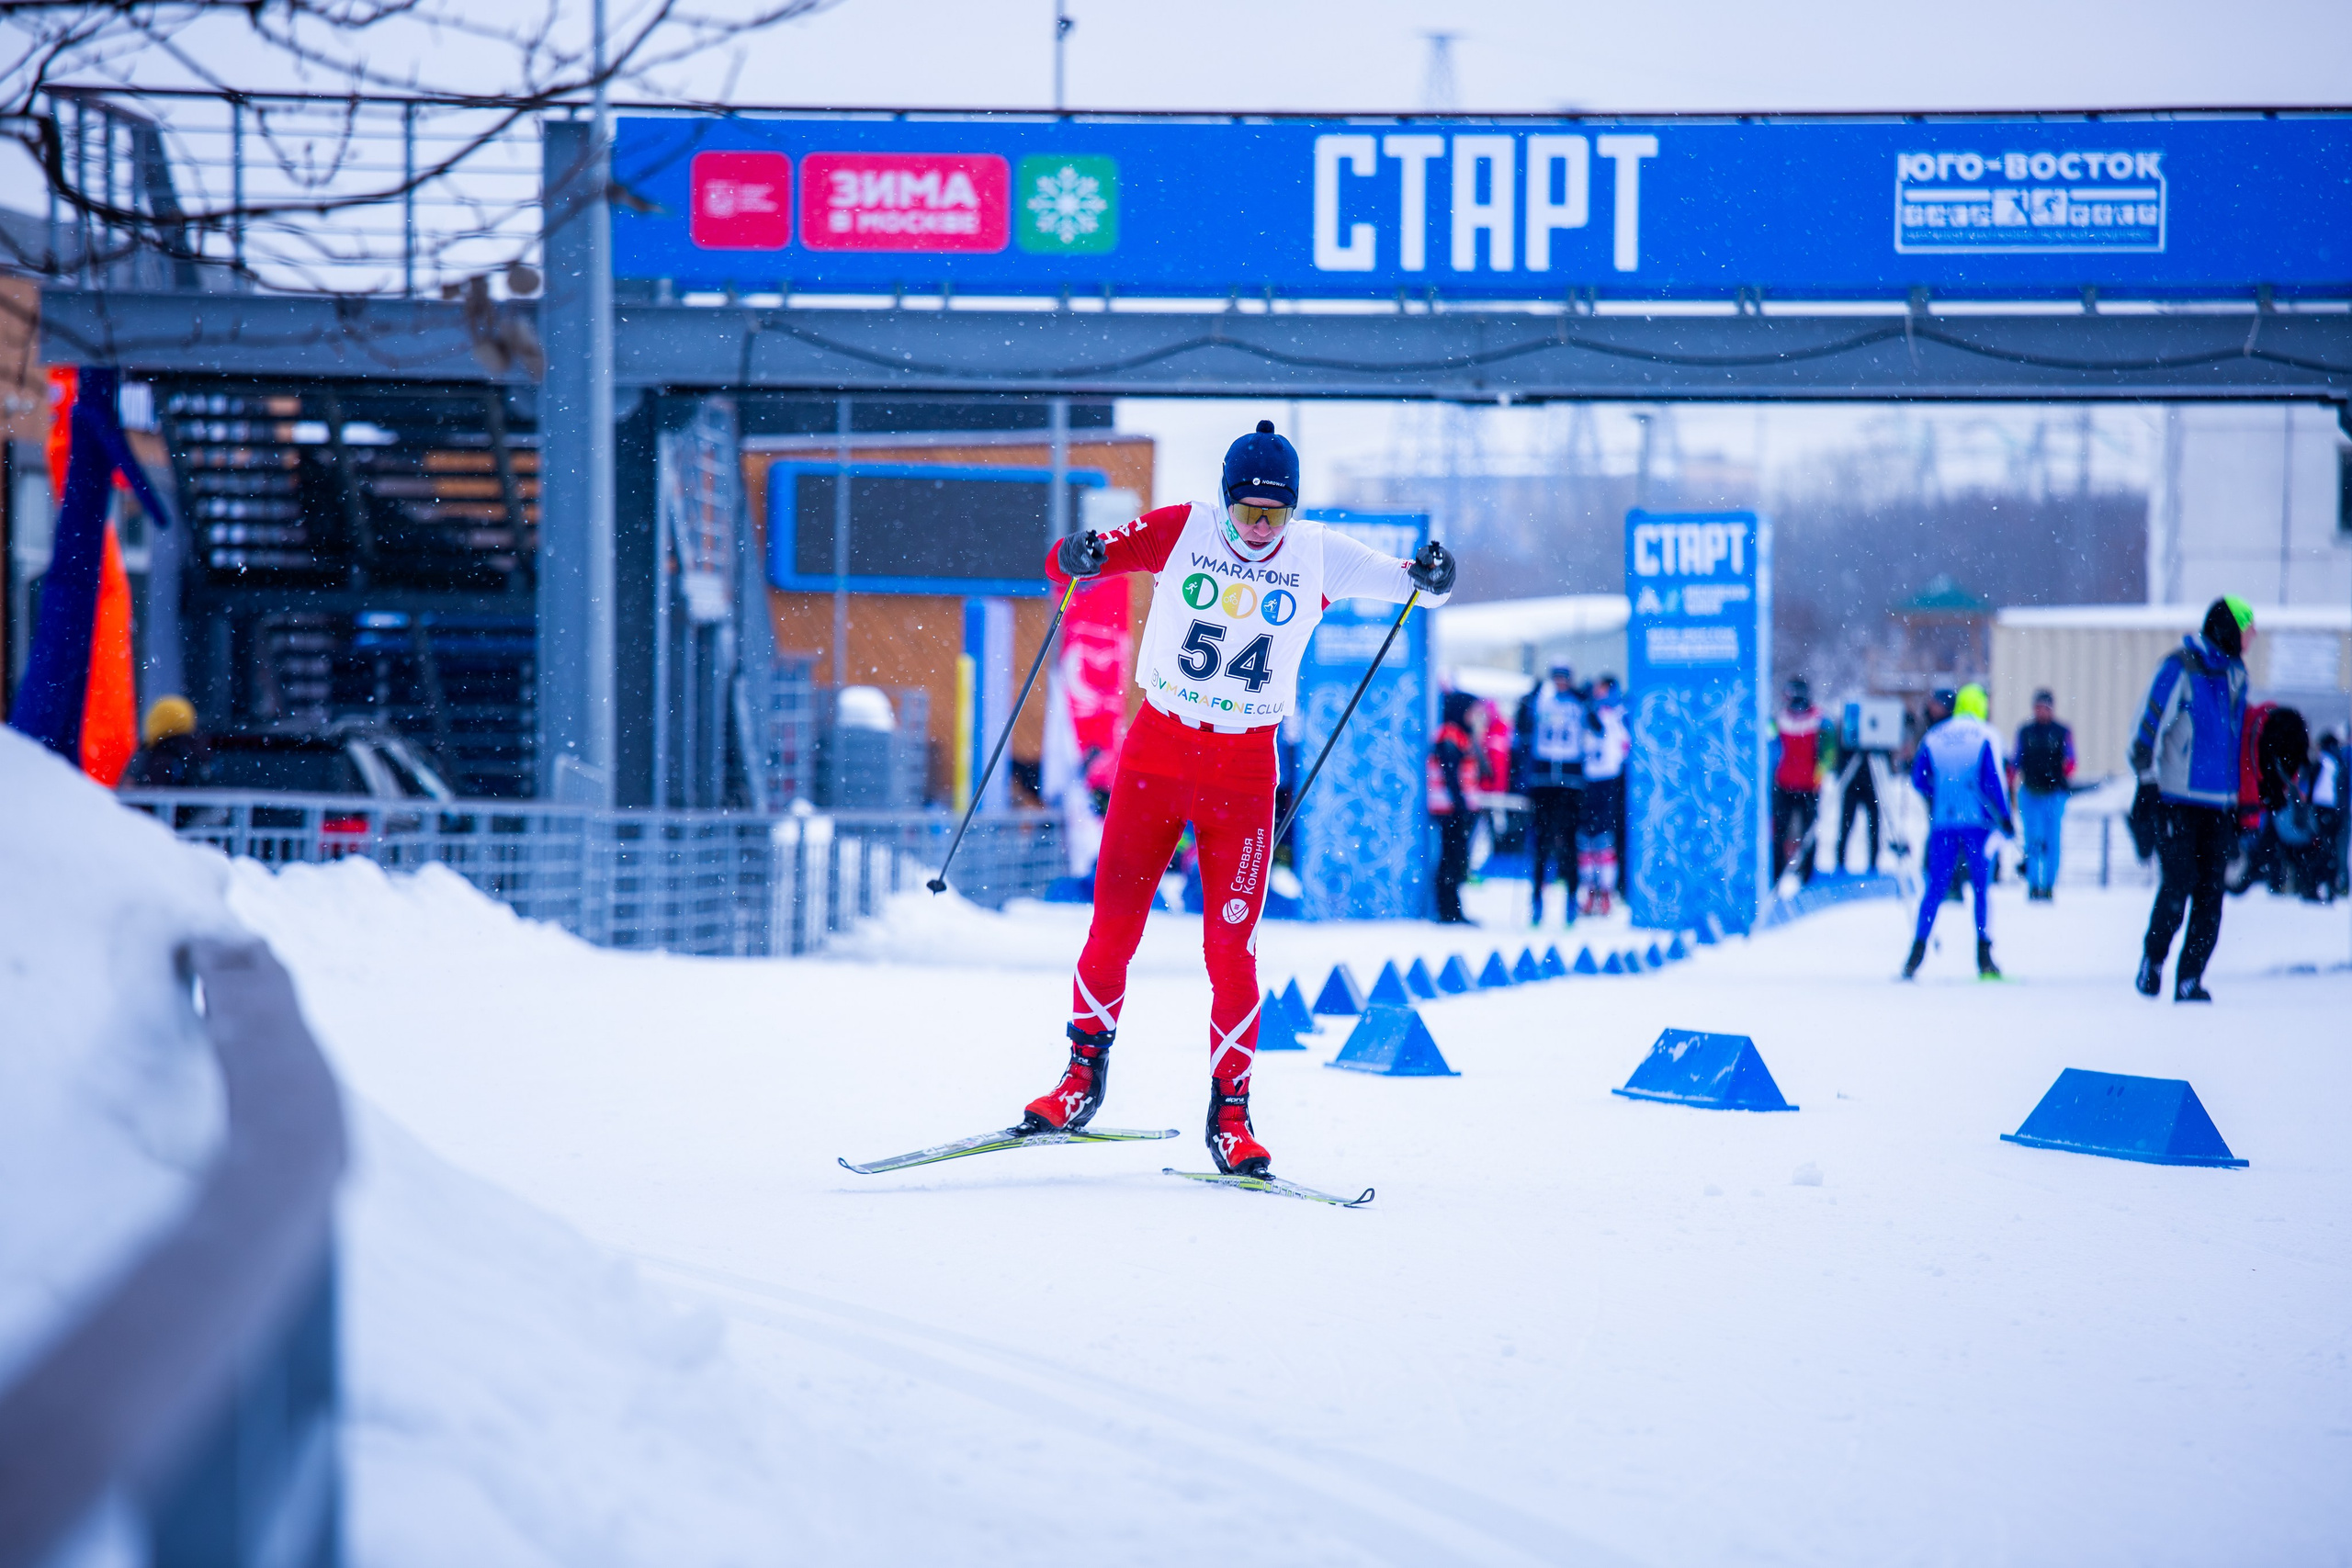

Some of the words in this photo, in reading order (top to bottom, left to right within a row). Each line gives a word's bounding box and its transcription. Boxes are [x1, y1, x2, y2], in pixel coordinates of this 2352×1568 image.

[1896, 152, 2163, 182] ЮГО-ВОСТОК
[828, 169, 981, 209] ЗИМА
[1314, 134, 1659, 273] СТАРТ
[829, 210, 853, 233] В
[856, 210, 981, 234] МОСКВЕ
[1261, 479, 1286, 488] NORDWAY
[1634, 522, 1748, 577] СТАРТ
[1191, 552, 1300, 588] VMARAFONE
[1177, 618, 1274, 694] 54
[1230, 837, 1253, 892] Сетевая
[1242, 828, 1265, 895] Компания
[1021, 1132, 1072, 1147] FISCHER
